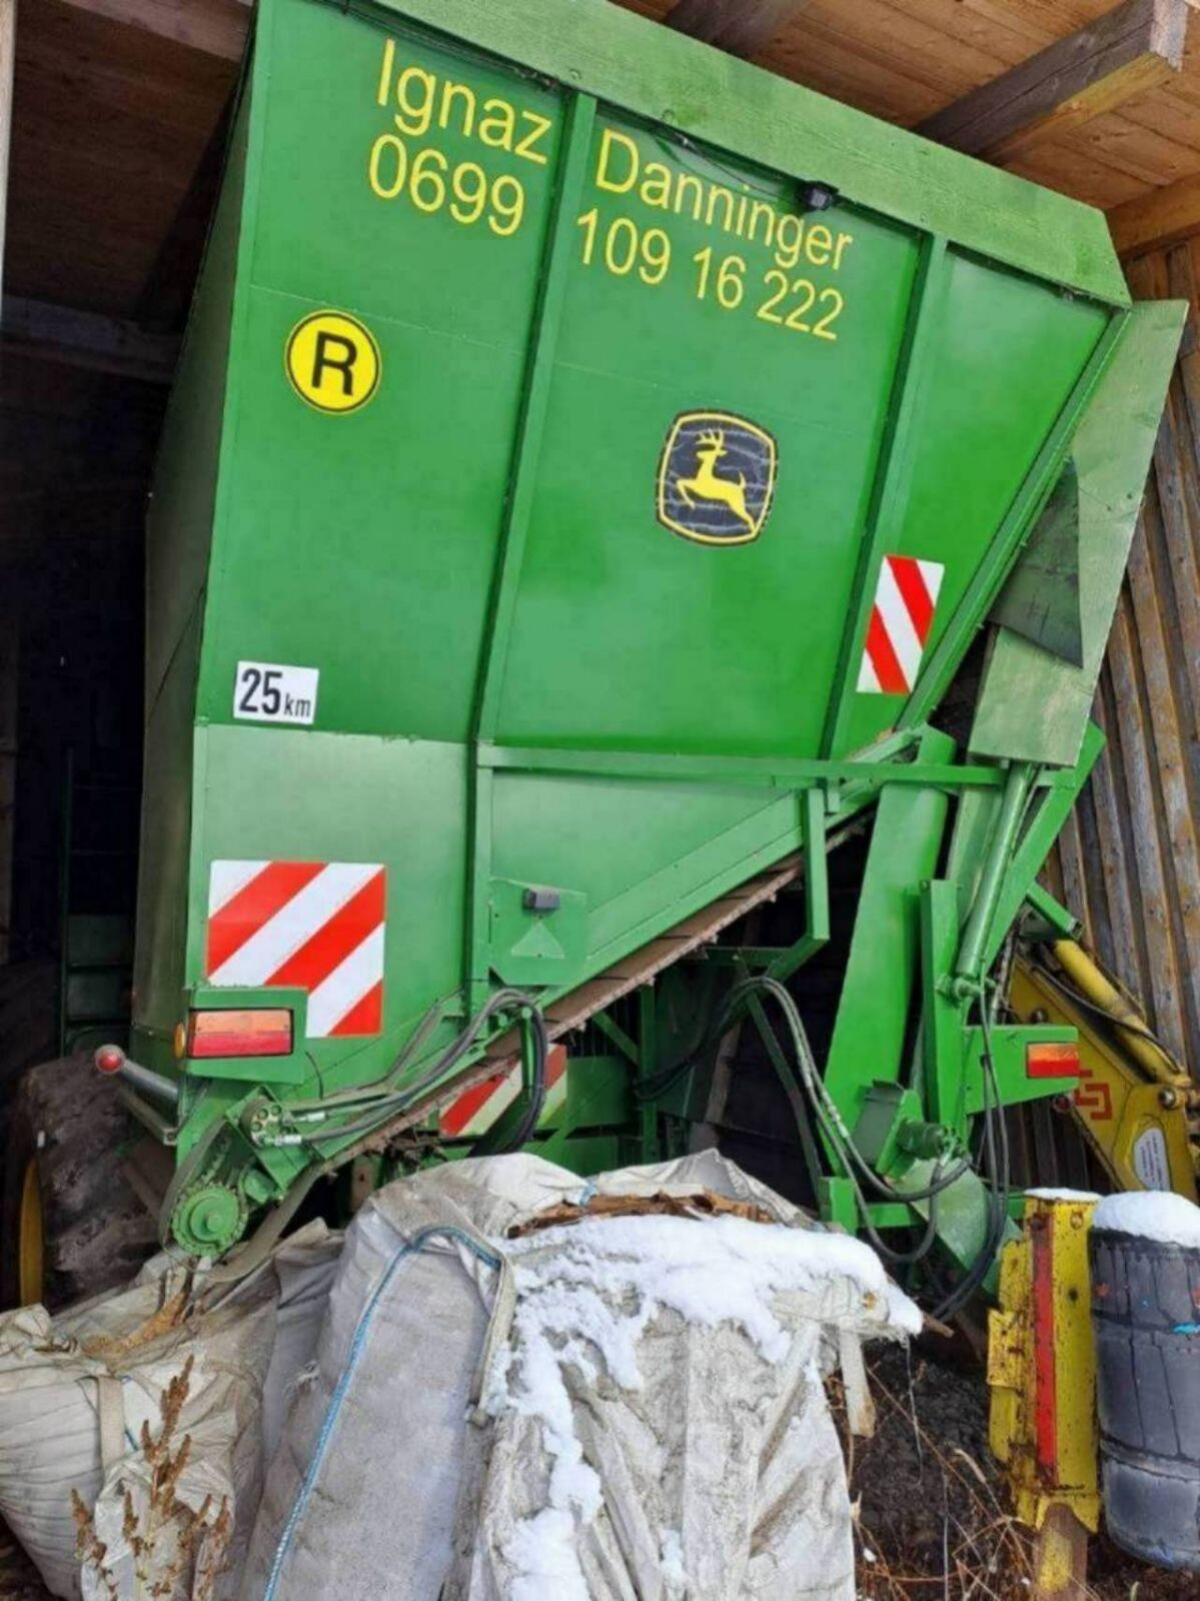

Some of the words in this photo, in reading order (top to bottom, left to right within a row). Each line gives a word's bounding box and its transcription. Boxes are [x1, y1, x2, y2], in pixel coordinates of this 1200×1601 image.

[375, 38, 554, 165] Ignaz
[595, 128, 854, 270] Danninger
[368, 133, 525, 237] 0699
[575, 208, 671, 285] 109
[692, 246, 747, 309] 16
[755, 270, 845, 341] 222
[311, 330, 358, 397] R
[239, 668, 282, 715] 25
[284, 692, 311, 718] km
